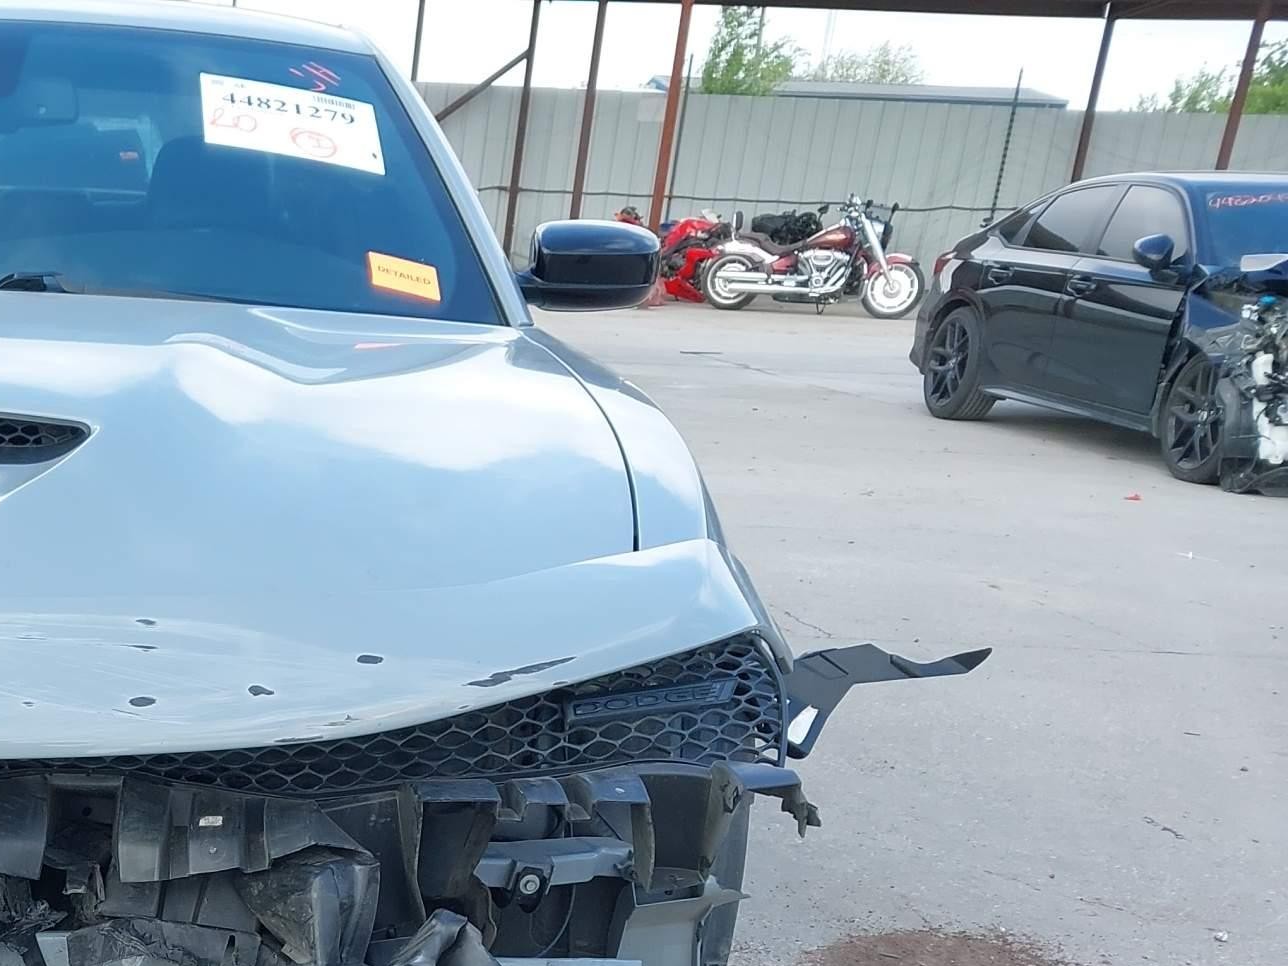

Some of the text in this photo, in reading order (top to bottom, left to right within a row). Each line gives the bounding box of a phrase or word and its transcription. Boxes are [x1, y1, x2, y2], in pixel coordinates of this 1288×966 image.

[222, 92, 355, 125] 44821279
[377, 265, 431, 285] DETAILED
[573, 684, 719, 716] DODGE
